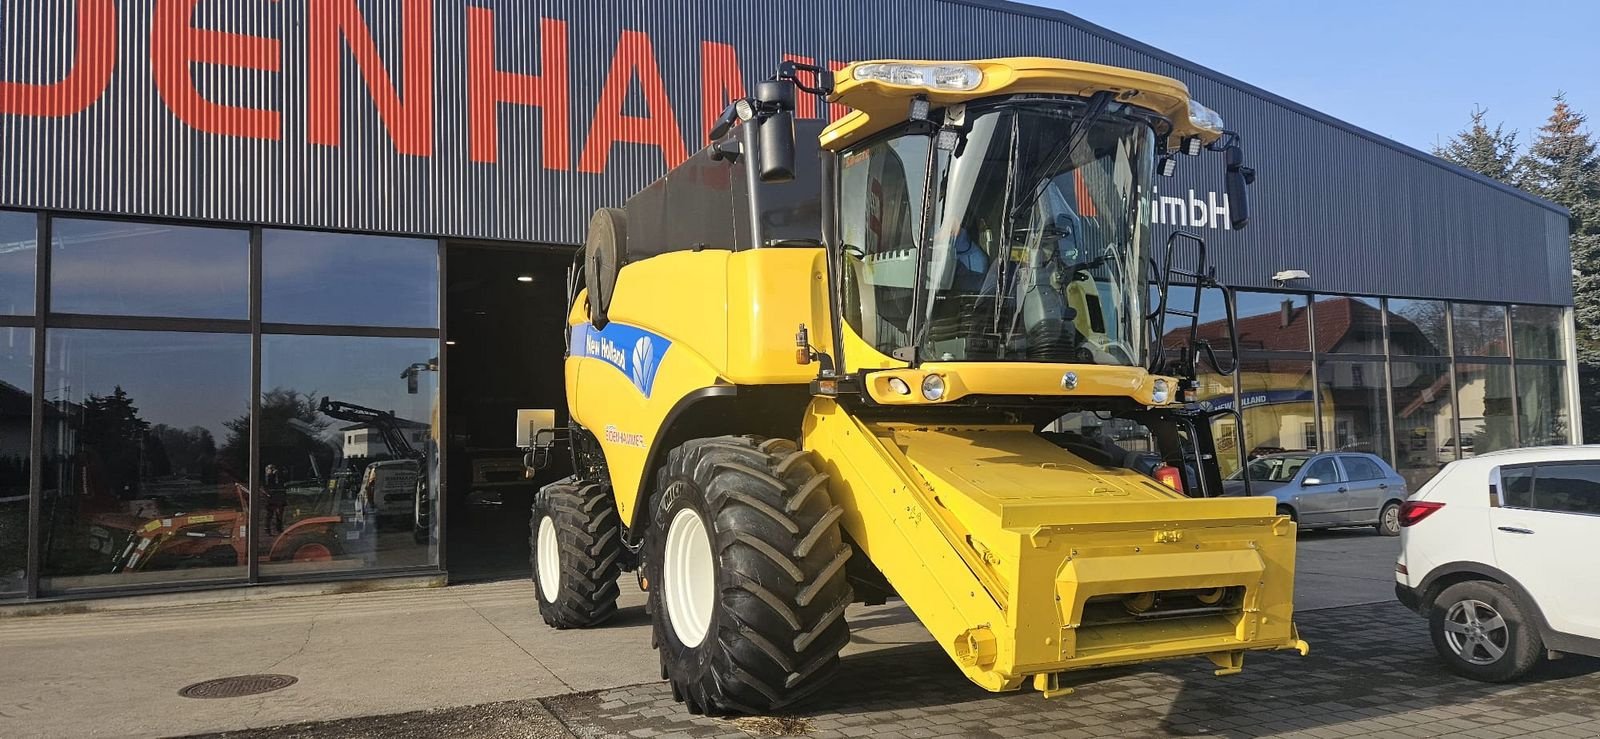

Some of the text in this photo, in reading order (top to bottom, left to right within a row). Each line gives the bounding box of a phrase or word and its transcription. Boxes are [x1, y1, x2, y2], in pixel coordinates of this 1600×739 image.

[1150, 184, 1231, 231] mbH
[586, 334, 626, 371] New Holland
